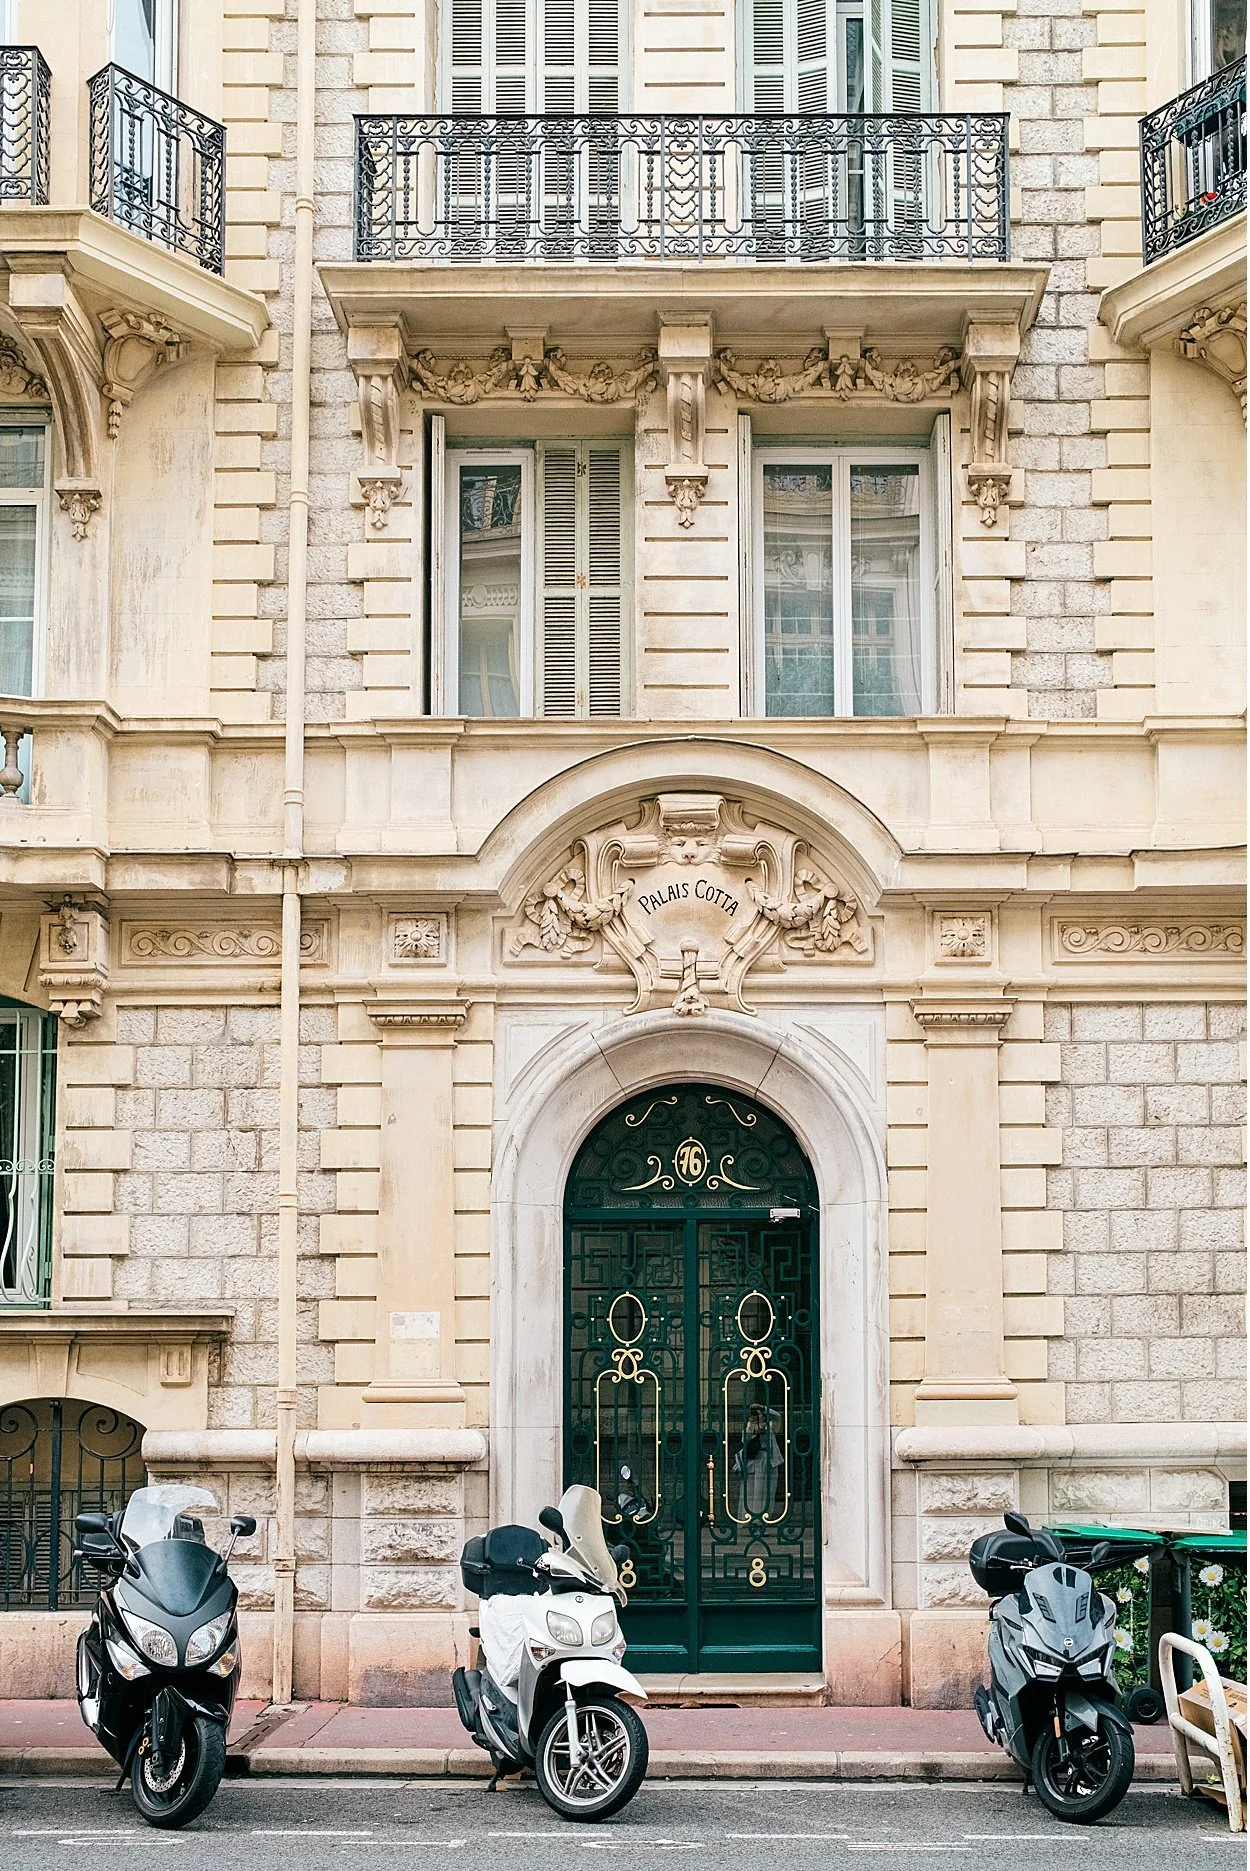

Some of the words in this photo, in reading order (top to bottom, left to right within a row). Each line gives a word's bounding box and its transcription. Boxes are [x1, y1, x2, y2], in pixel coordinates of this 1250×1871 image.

[637, 882, 690, 916] PALAIS
[694, 879, 740, 917] COTTA
[679, 1146, 702, 1176] 76
